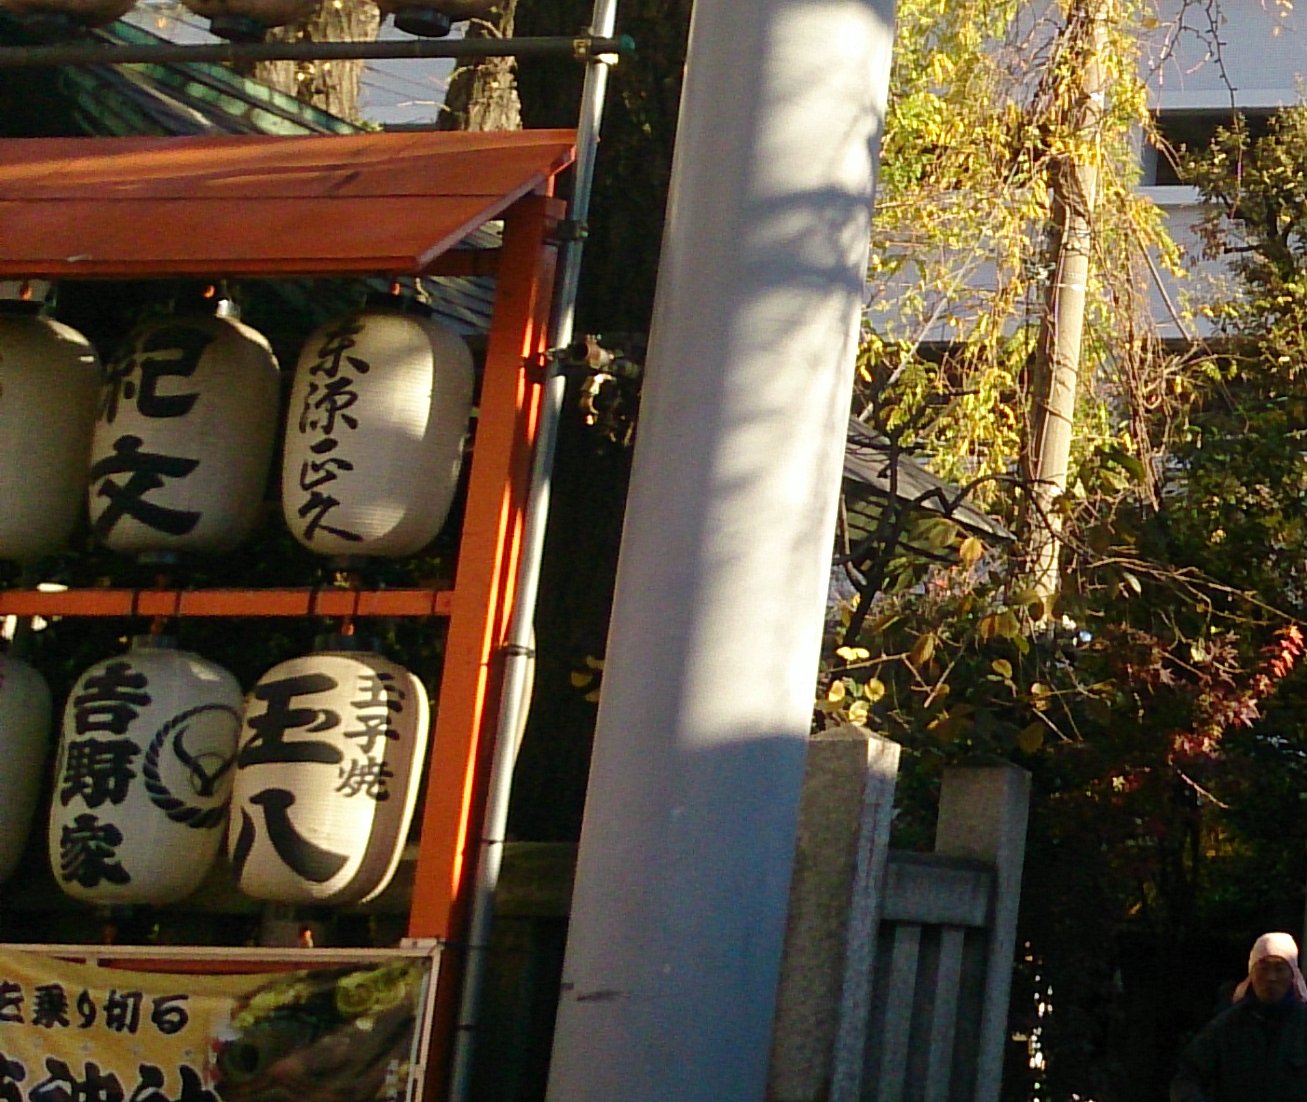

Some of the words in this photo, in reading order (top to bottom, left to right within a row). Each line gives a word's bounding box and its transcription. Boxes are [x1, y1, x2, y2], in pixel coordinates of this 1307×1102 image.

[91, 325, 216, 537] 紀文
[335, 672, 405, 802] 玉子焼
